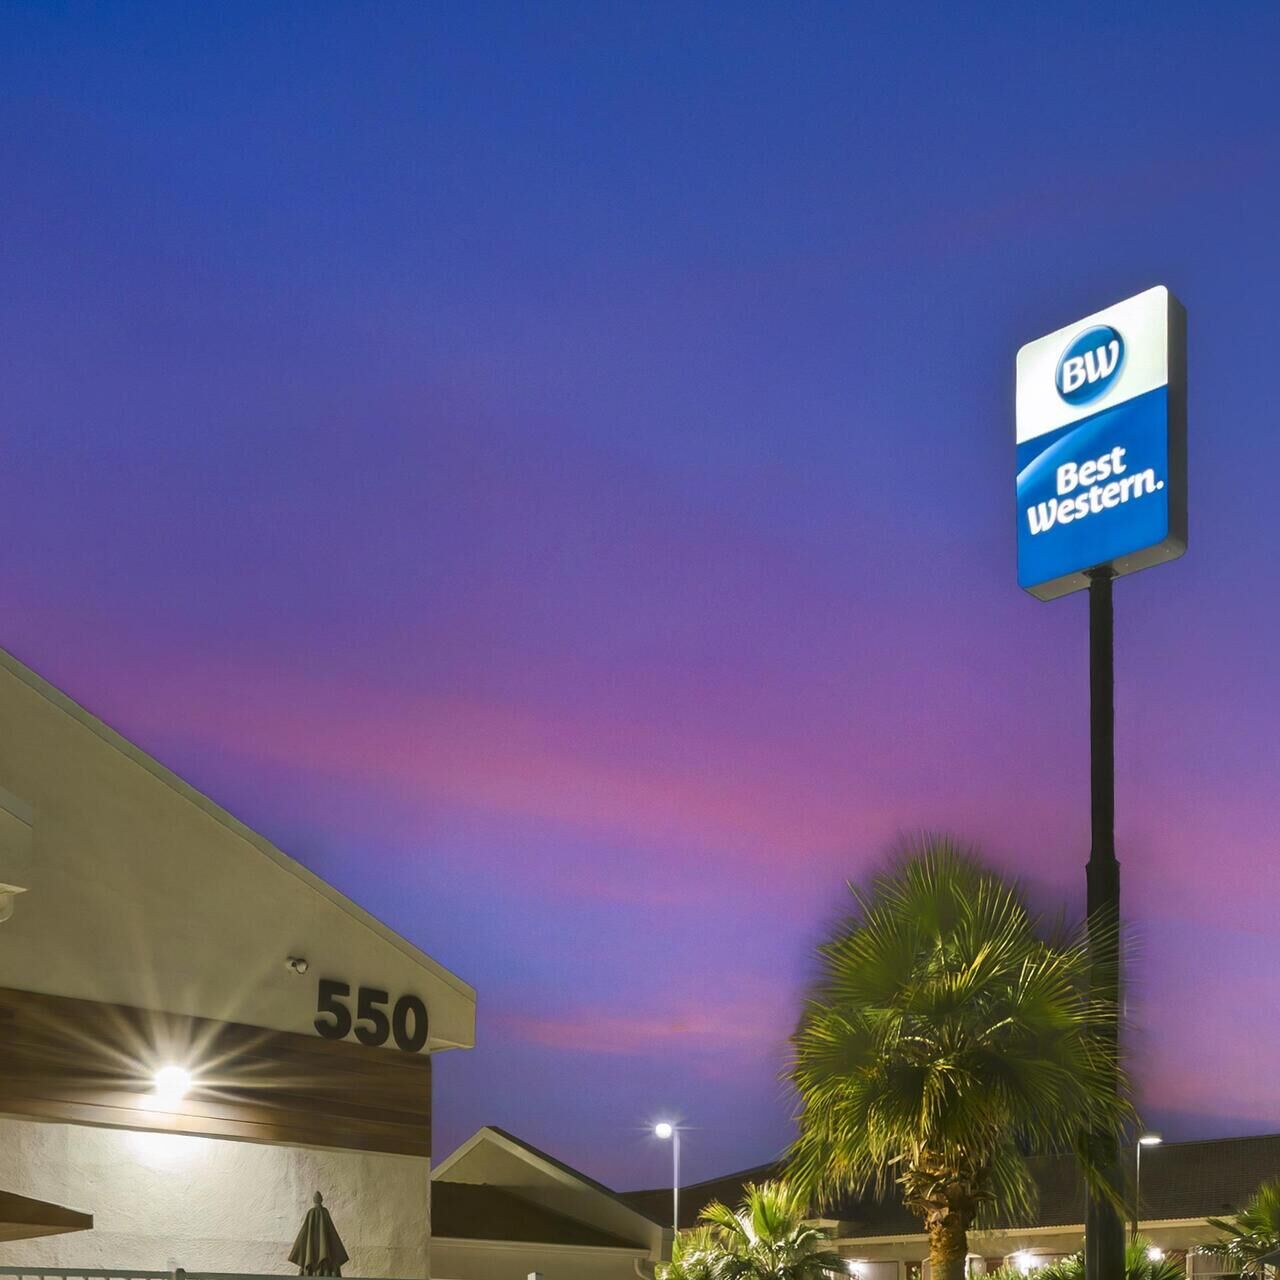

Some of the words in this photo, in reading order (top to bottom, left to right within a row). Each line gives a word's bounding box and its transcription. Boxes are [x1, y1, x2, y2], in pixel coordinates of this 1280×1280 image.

[1062, 340, 1120, 394] BW
[1056, 446, 1126, 496] Best
[313, 978, 429, 1052] 550
